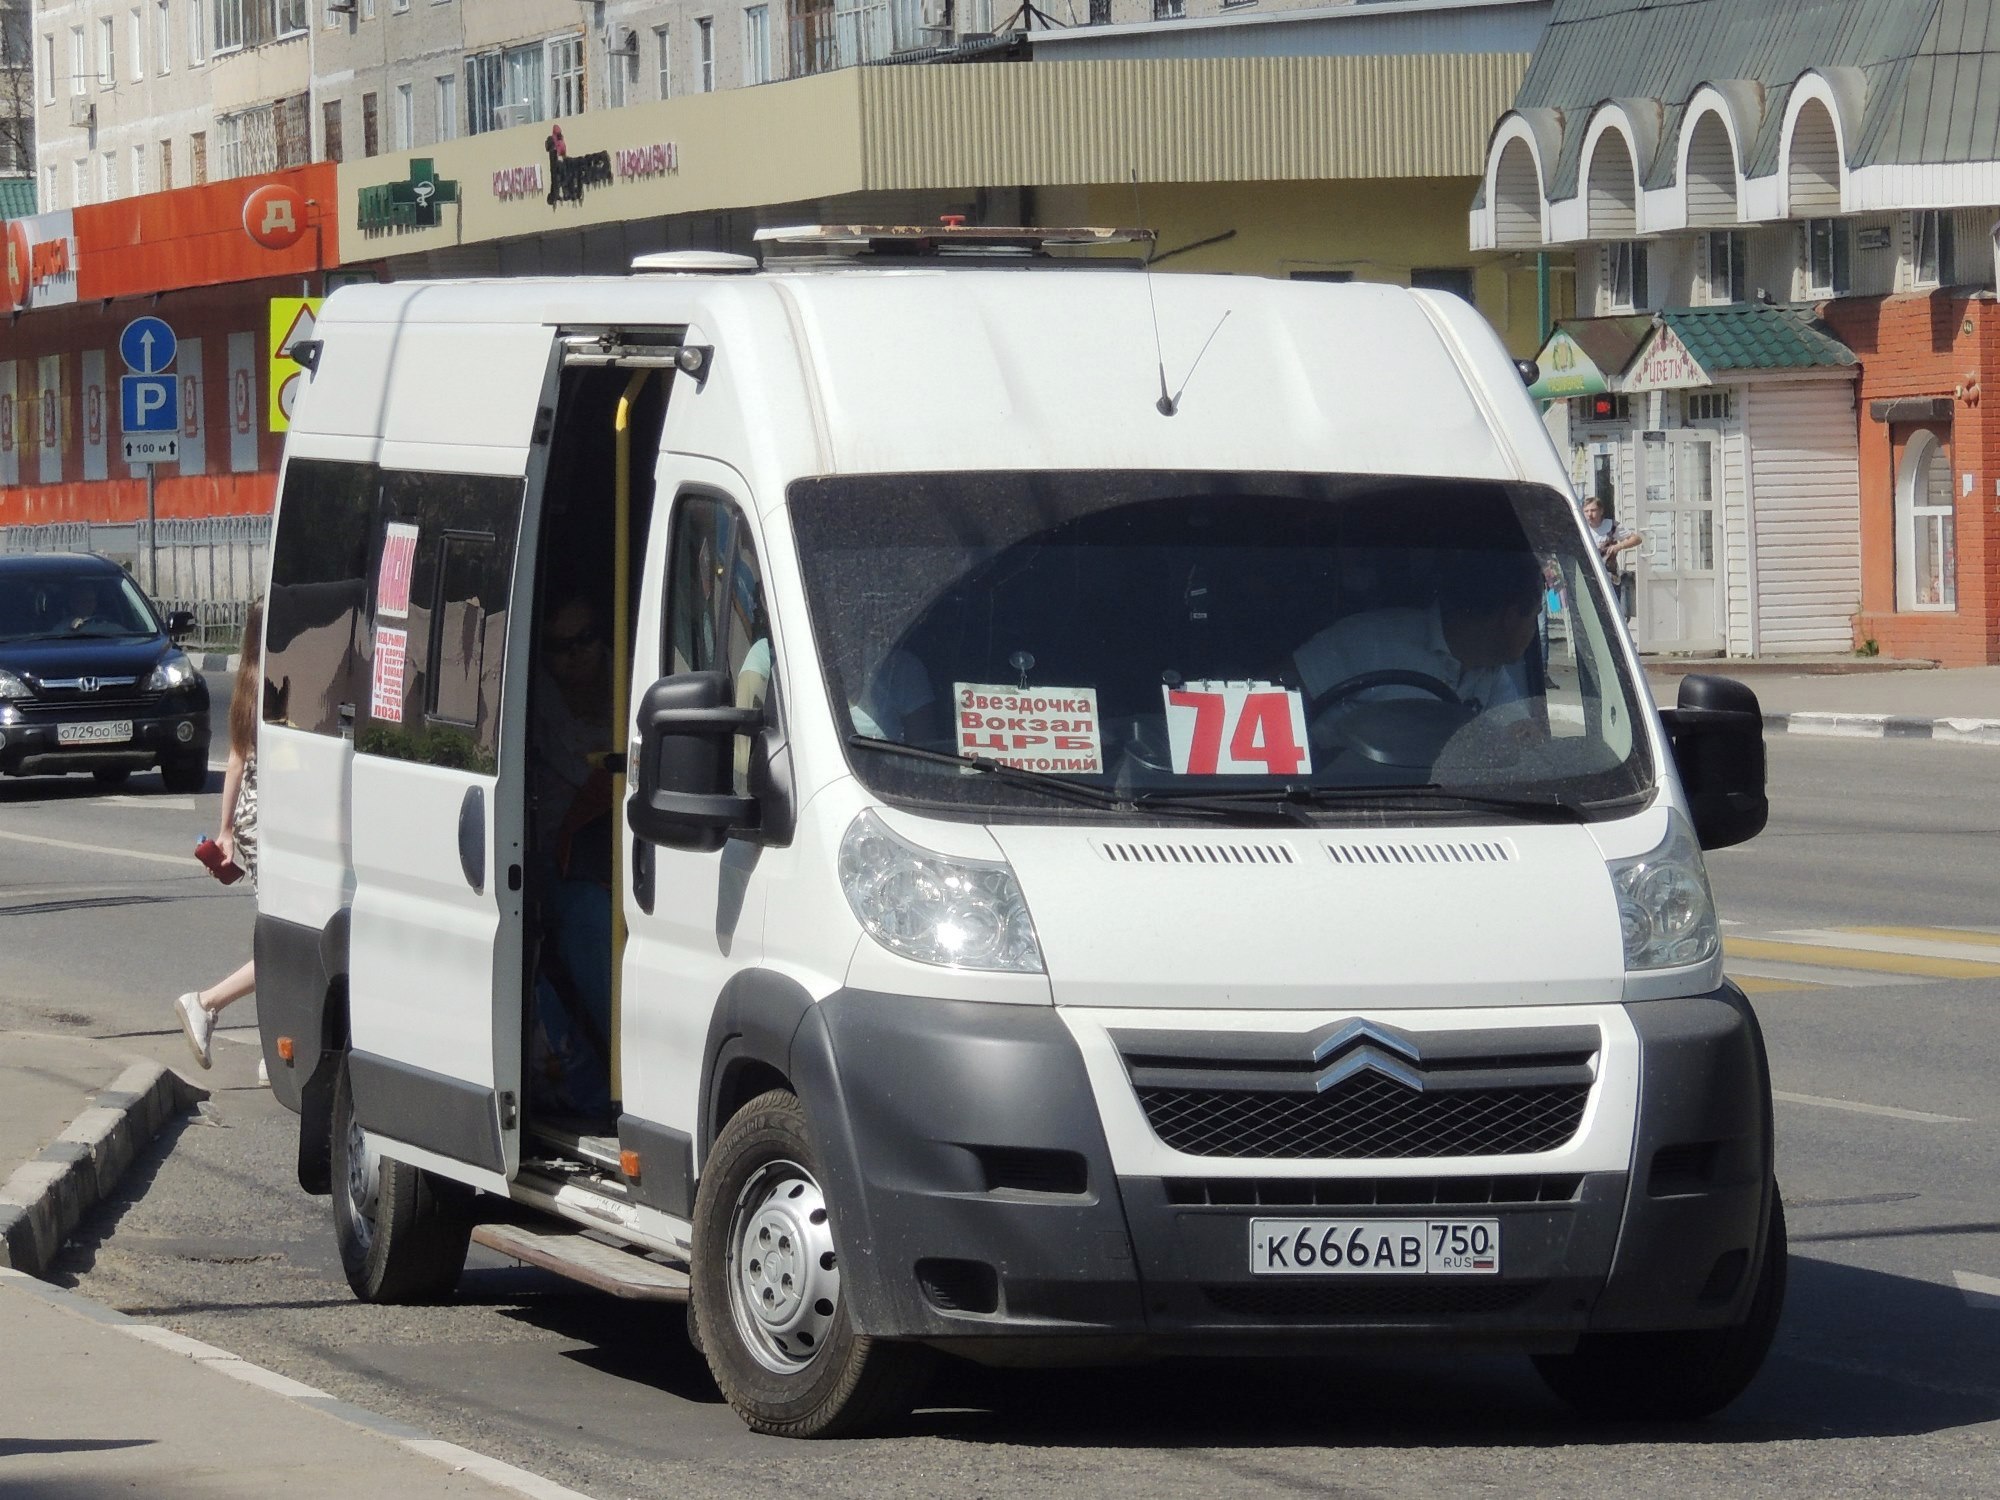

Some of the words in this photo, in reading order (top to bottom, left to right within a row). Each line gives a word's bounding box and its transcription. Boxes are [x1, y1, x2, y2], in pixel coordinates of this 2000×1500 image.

[262, 200, 296, 235] Д
[1649, 358, 1683, 385] ЦВЕТЫ
[136, 382, 167, 426] P
[136, 443, 155, 454] 100
[374, 704, 401, 721] ЛОЗА
[960, 689, 1091, 715] Звездочка
[960, 711, 1093, 733] Вокзал
[1168, 690, 1306, 774] 74
[962, 733, 1095, 752] ЦРБ
[1431, 1225, 1490, 1256] 750
[1443, 1257, 1472, 1269] RUS
